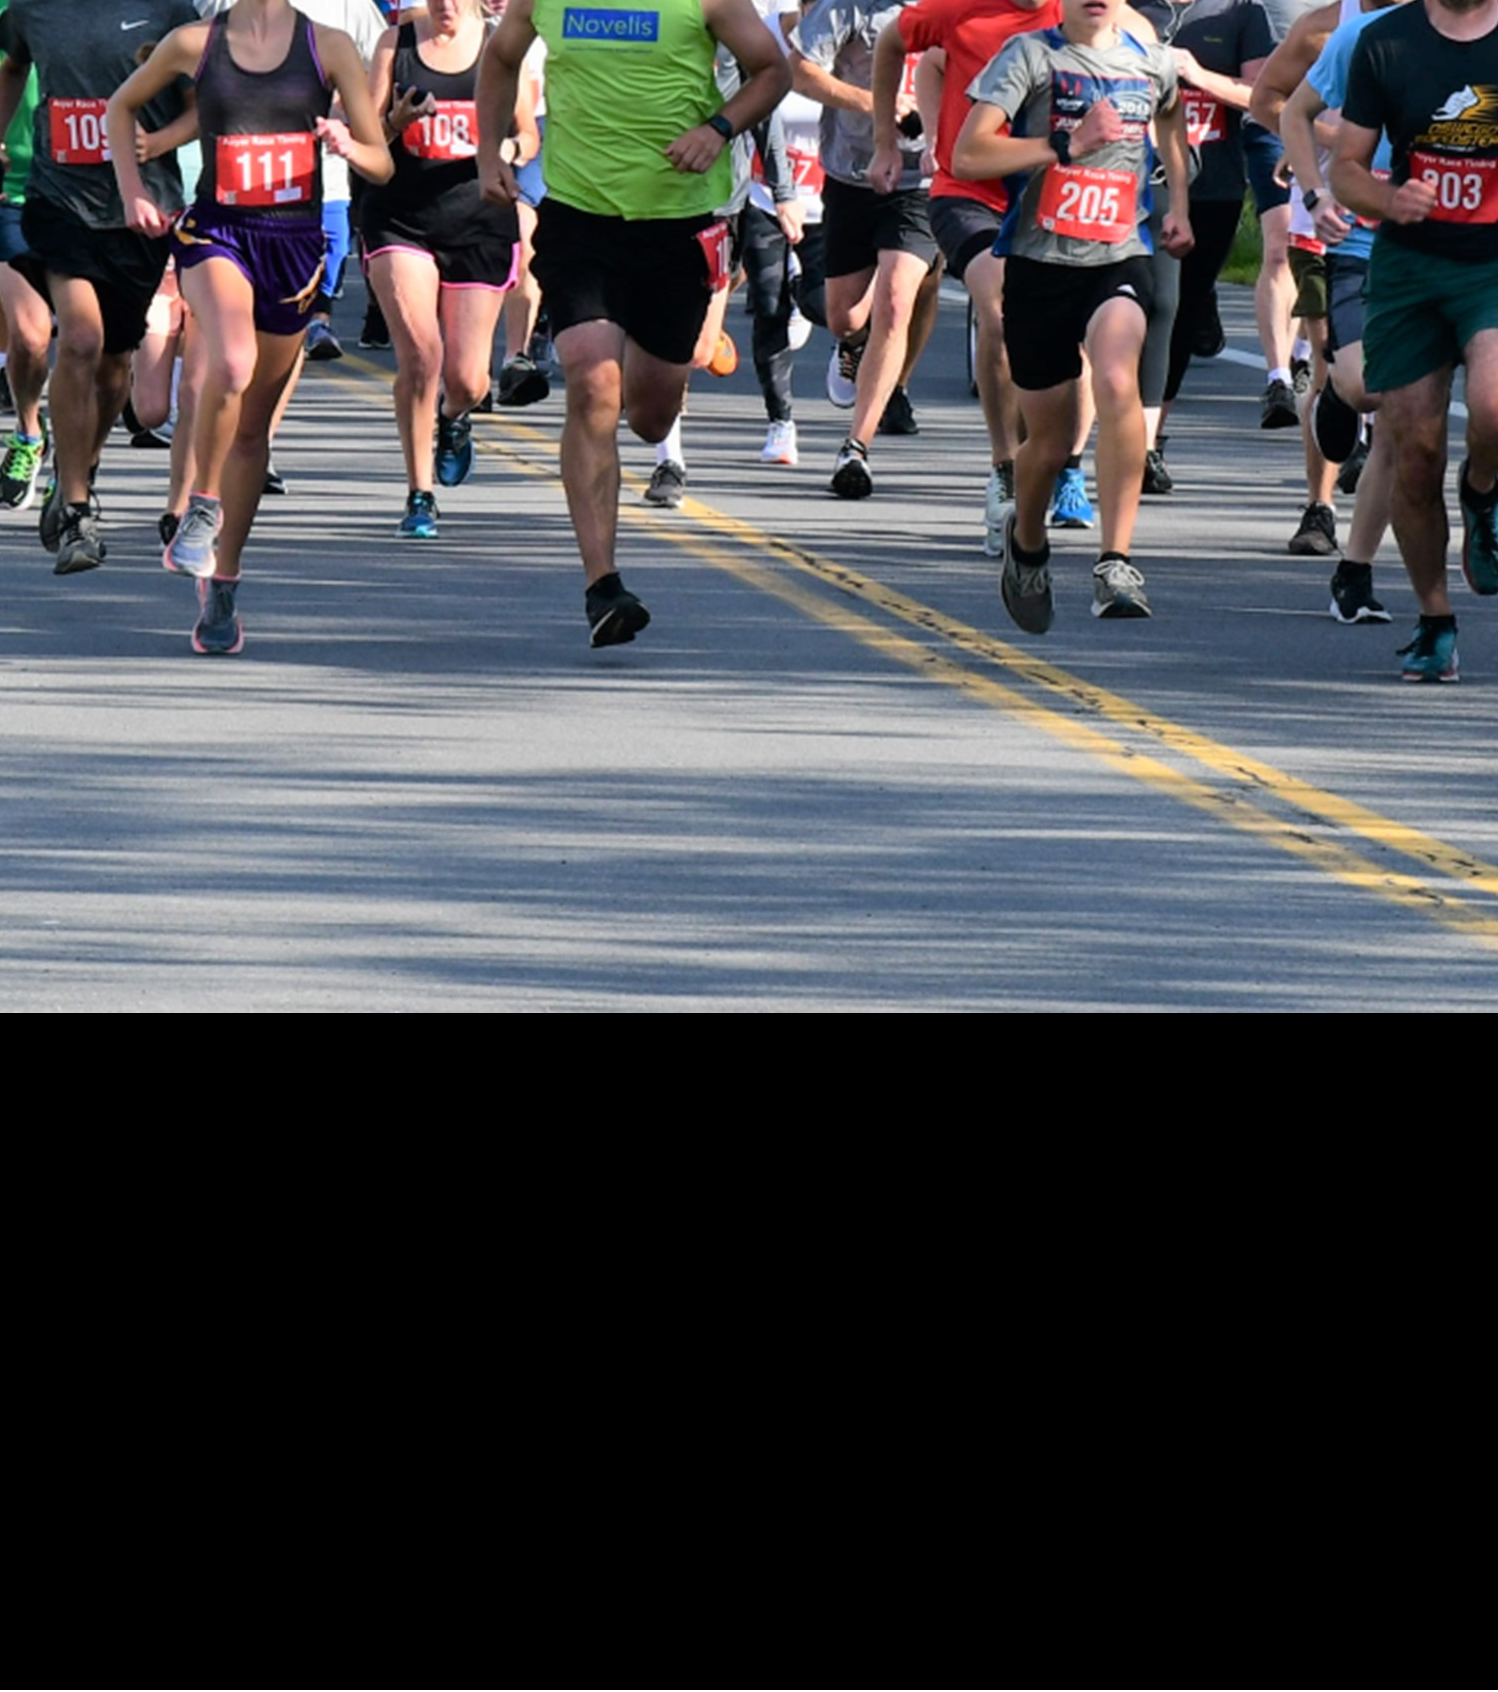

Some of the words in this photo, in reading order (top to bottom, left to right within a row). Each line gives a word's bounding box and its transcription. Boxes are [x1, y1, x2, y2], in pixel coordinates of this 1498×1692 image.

[566, 14, 653, 37] Novelis
[419, 113, 470, 147] 108
[1184, 101, 1216, 137] 57
[236, 150, 293, 192] 111
[1056, 181, 1120, 227] 205
